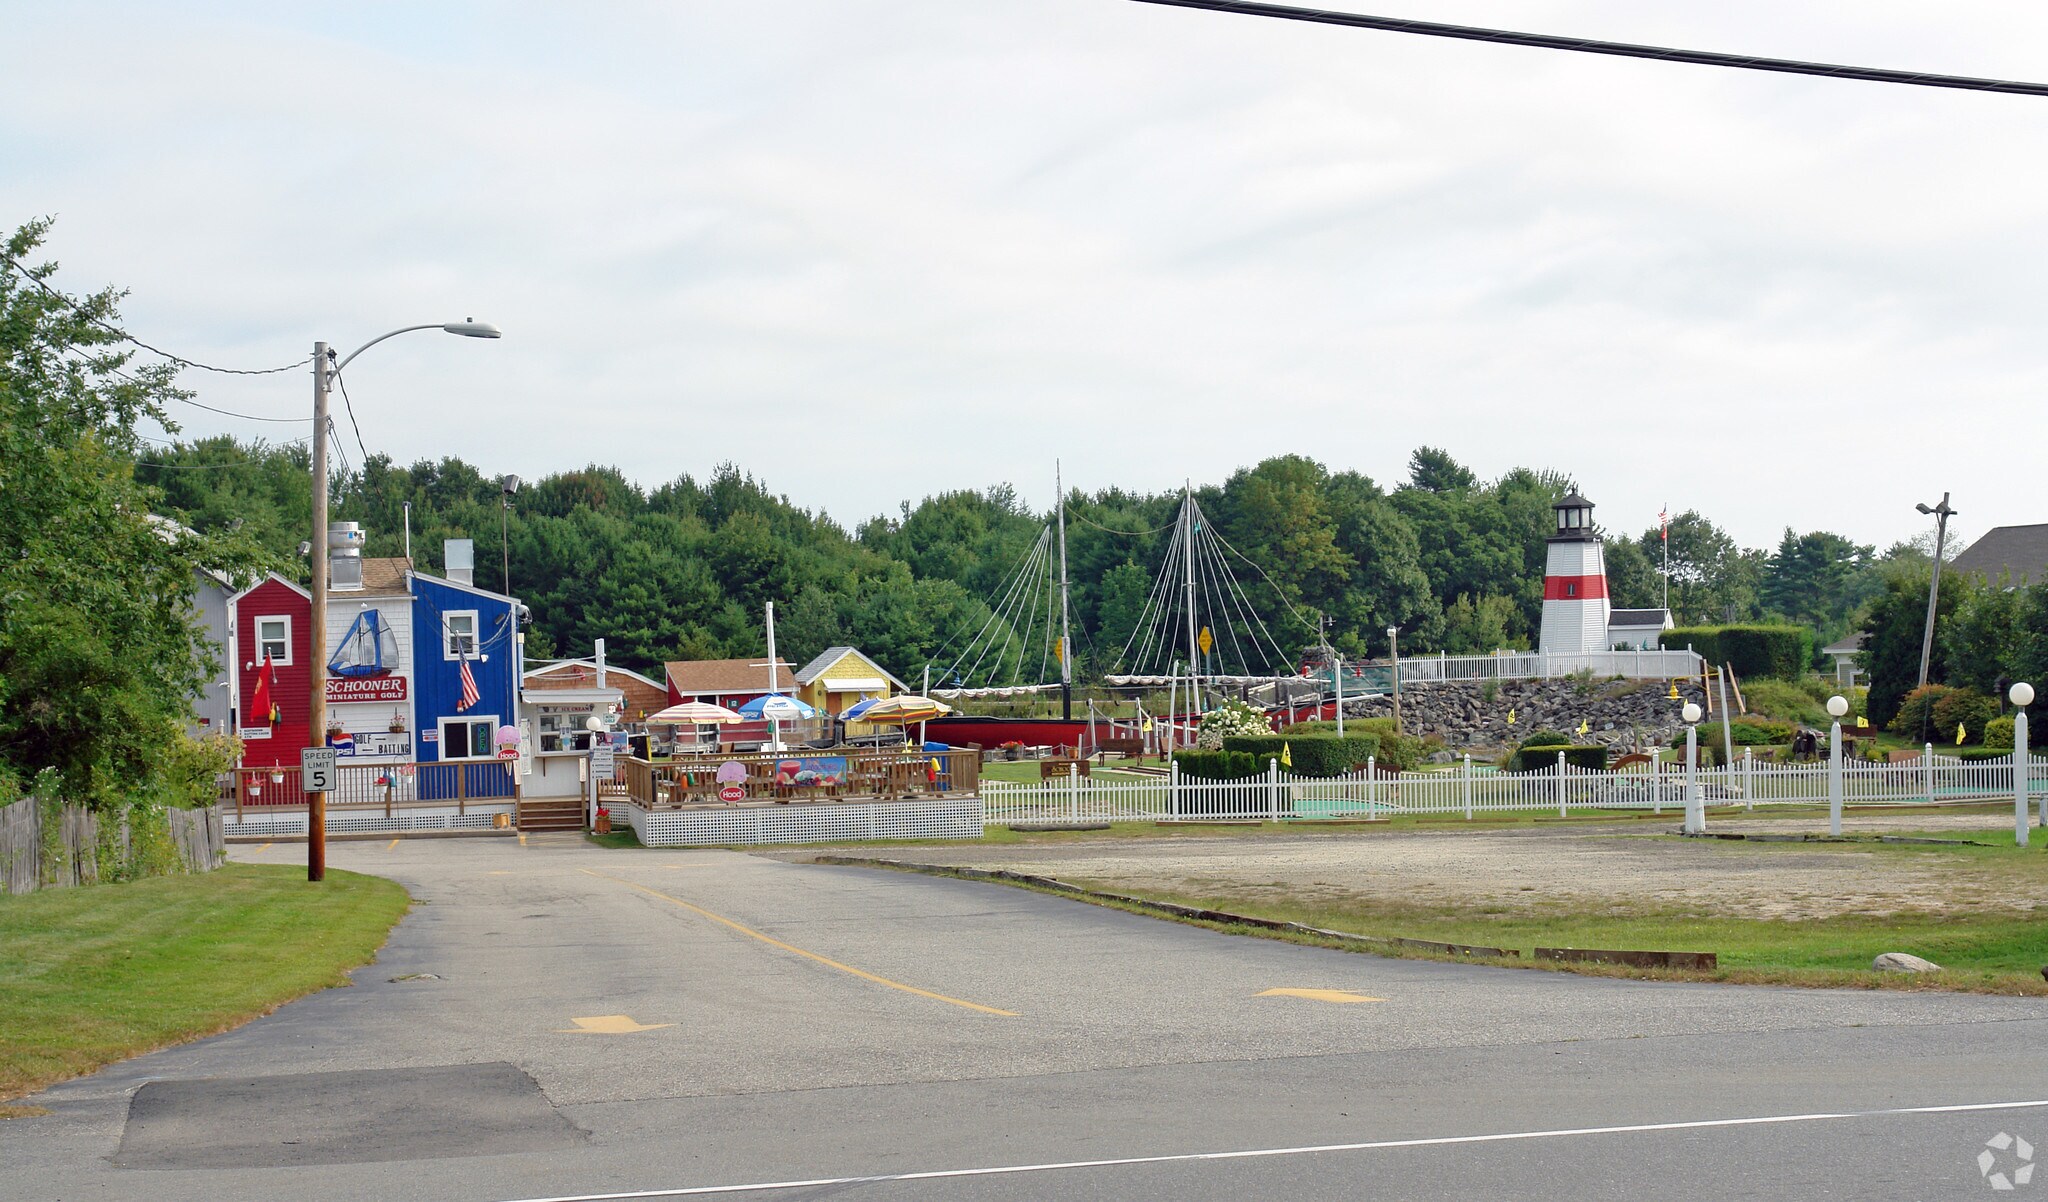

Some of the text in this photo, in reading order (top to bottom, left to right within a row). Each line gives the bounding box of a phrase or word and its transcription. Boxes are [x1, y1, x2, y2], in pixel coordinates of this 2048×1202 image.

[326, 680, 404, 693] SCHOONER
[354, 734, 371, 744] GOLF
[378, 744, 409, 753] BATTING
[304, 752, 333, 760] SPEED
[313, 771, 326, 787] 5
